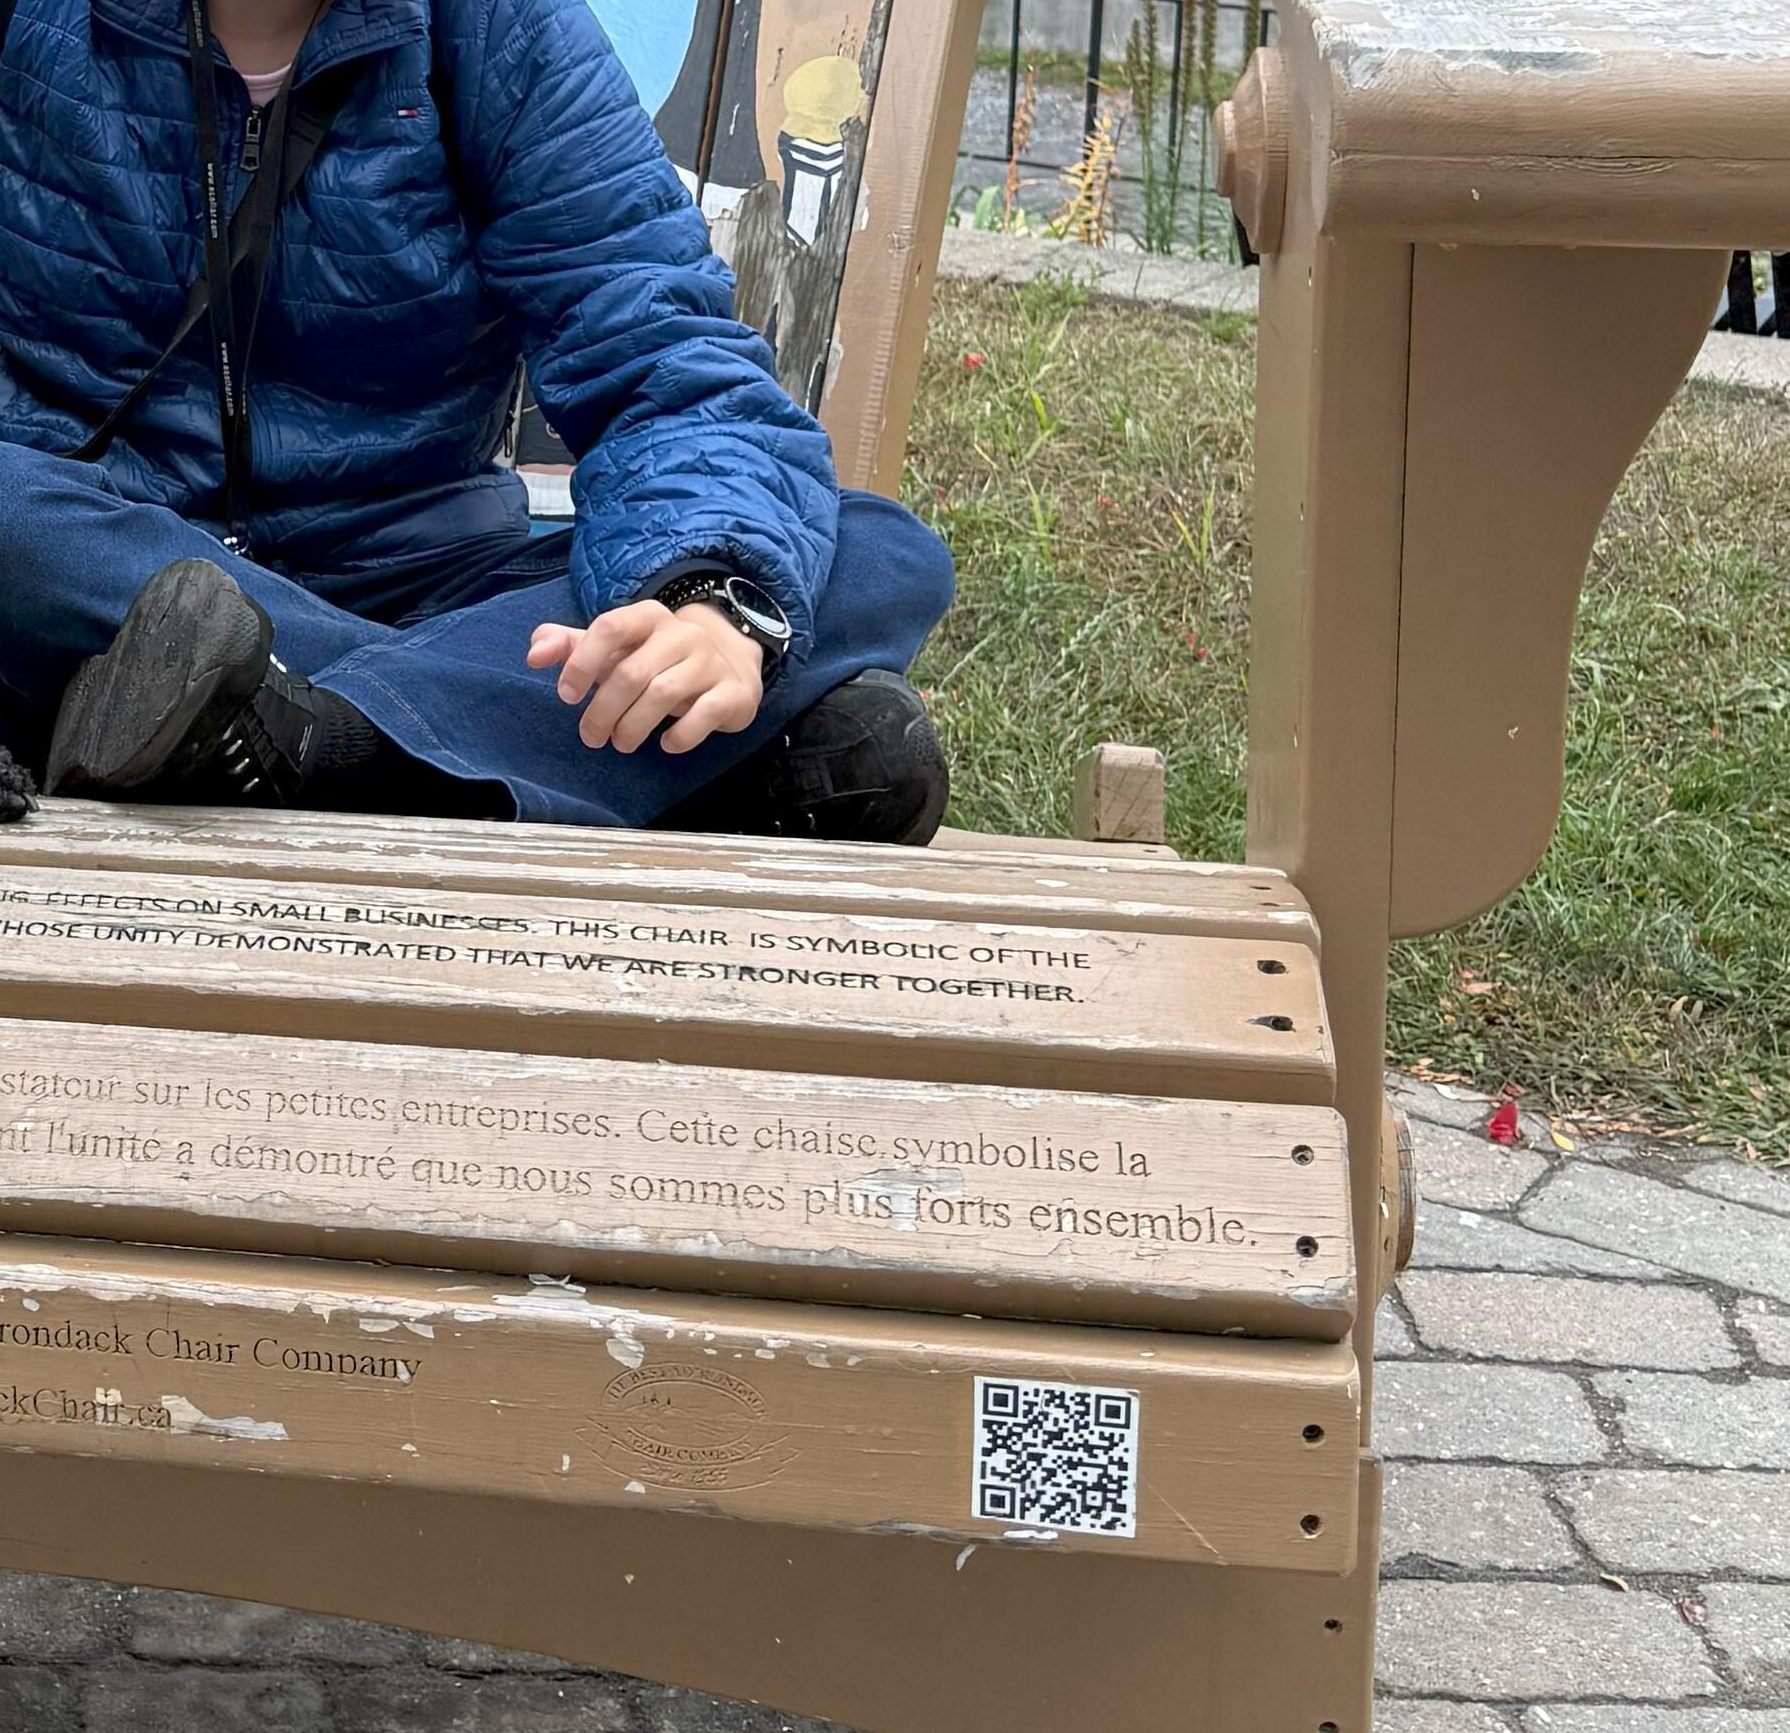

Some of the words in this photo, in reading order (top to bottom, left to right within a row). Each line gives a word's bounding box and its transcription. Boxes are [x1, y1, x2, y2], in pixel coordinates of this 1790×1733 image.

[46, 891, 167, 912] EFFECTS
[176, 899, 222, 915] ON
[233, 900, 331, 923] SMALL
[550, 919, 619, 939] THIS
[630, 924, 728, 947] CHAIR
[750, 932, 776, 950] IS
[786, 934, 959, 962] SYMBOLIC
[969, 946, 1015, 966] OF
[1025, 950, 1092, 970] THE
[93, 925, 185, 945] UNITY
[194, 932, 457, 962] DEMONSTRATED
[467, 947, 546, 969] THAT
[562, 954, 614, 974] WE
[624, 958, 688, 979] ARE
[698, 961, 880, 991] STRONGER
[894, 974, 1086, 1004] TOGETHER.
[134, 1082, 190, 1108] sur
[204, 1076, 251, 1113] les
[265, 1088, 387, 1124] petites
[401, 1098, 622, 1143] entreprises.
[636, 1108, 740, 1148] Cette
[753, 1117, 879, 1159] chaise
[892, 1133, 1100, 1174] symbolise
[1115, 1141, 1152, 1179] la
[210, 1134, 397, 1181] démontré
[411, 1152, 483, 1193] que
[498, 1164, 593, 1198] nous
[609, 1172, 786, 1213] sommes
[803, 1179, 894, 1225] plus
[911, 1186, 1012, 1229] forts
[1029, 1200, 1258, 1248] ensemble.
[146, 1328, 241, 1366] Chair
[253, 1337, 423, 1381] Company
